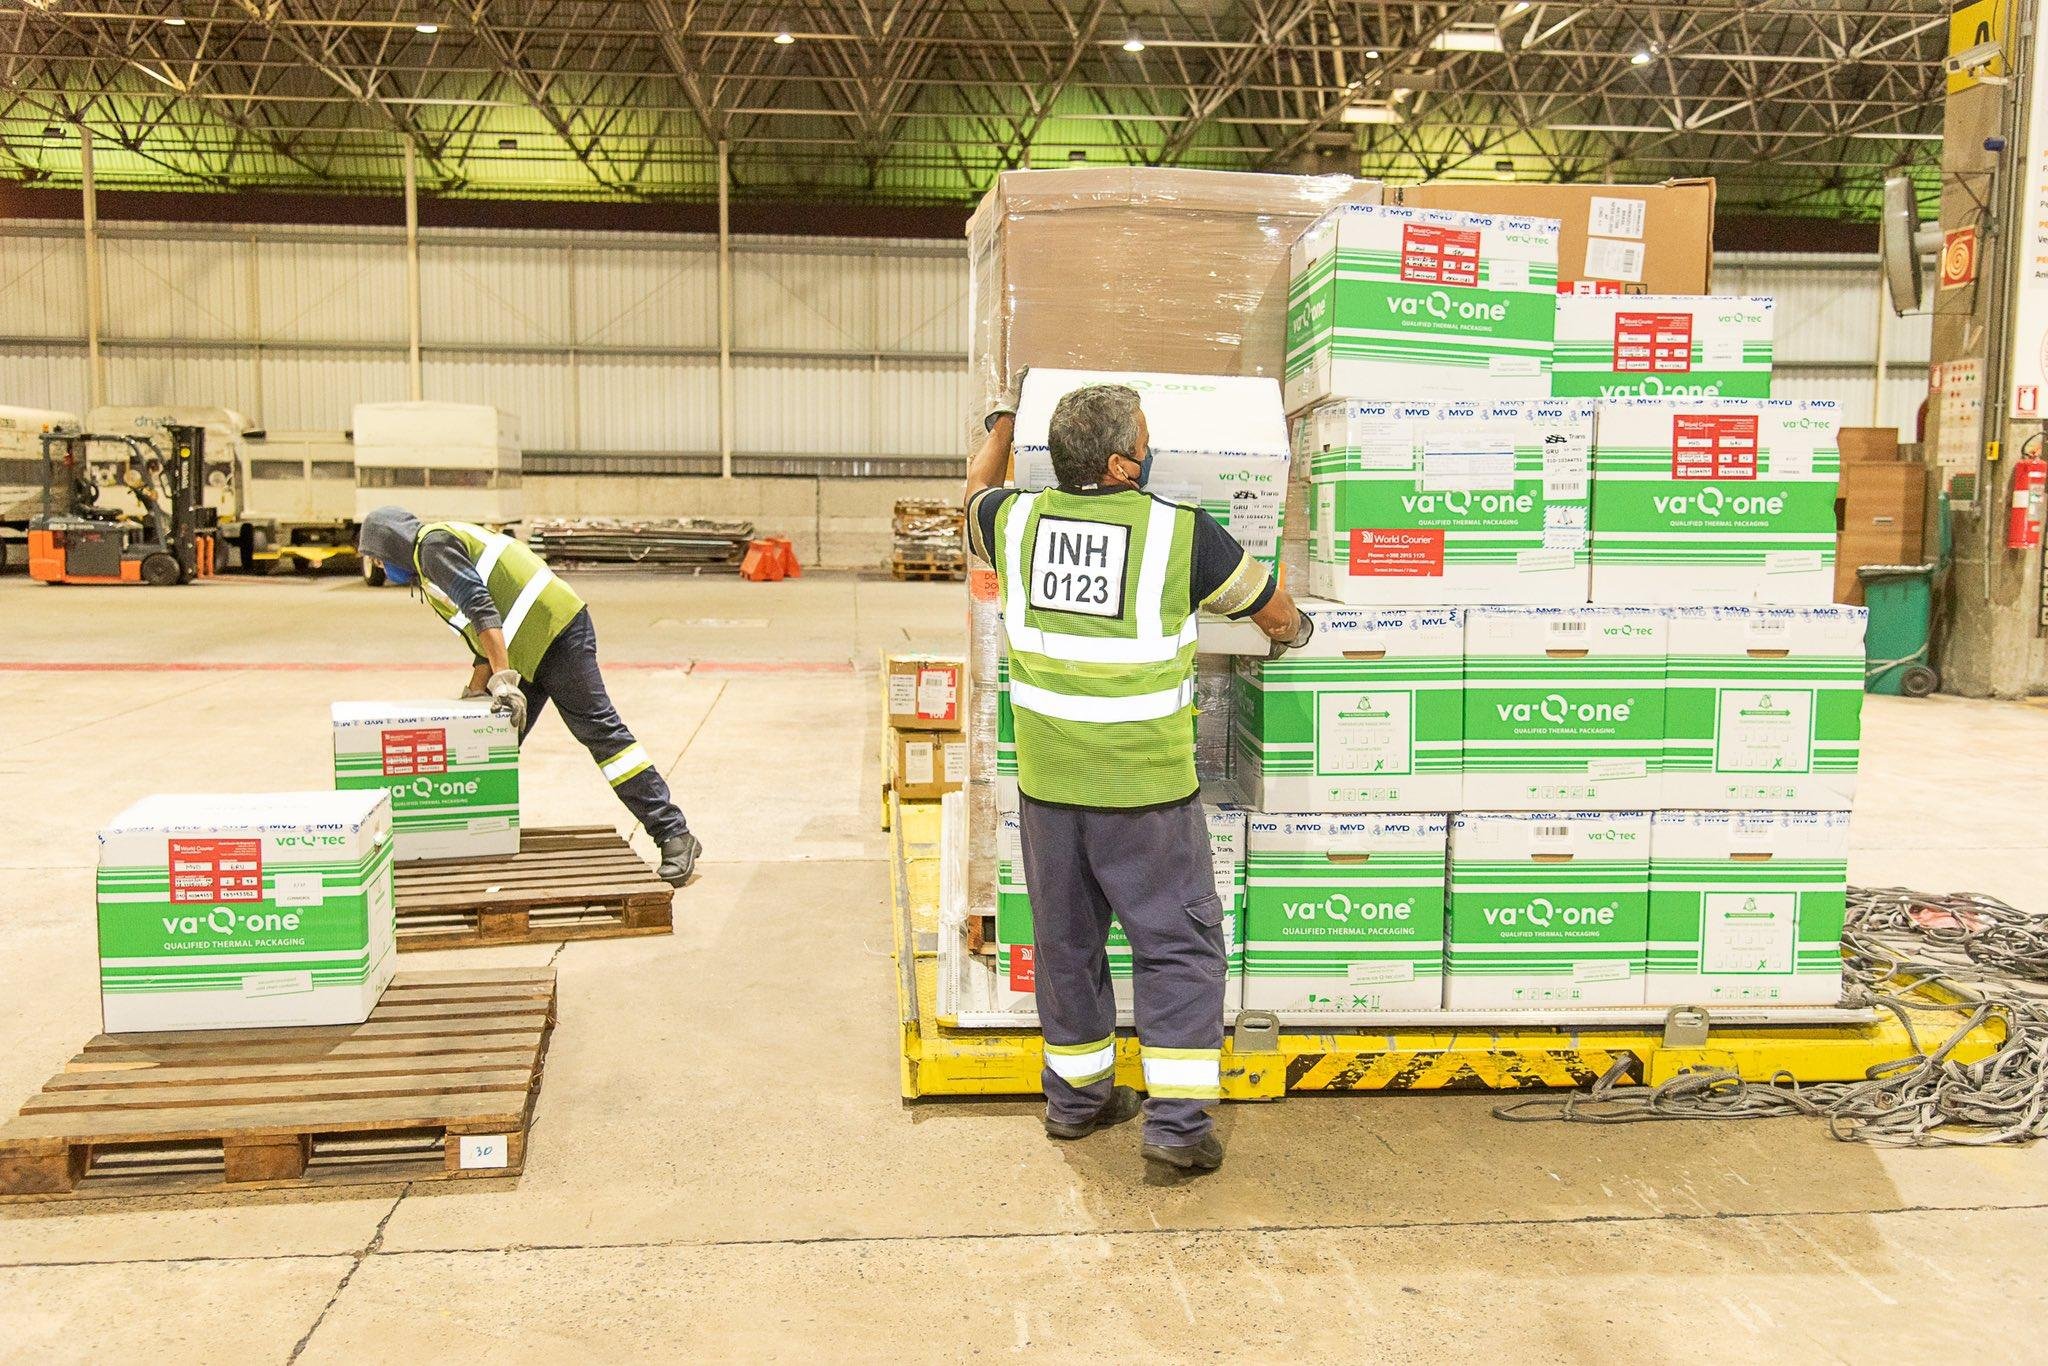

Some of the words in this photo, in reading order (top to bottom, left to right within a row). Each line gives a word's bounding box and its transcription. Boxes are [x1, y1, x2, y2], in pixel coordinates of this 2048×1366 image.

[1350, 205, 1373, 213] MVD
[1508, 222, 1531, 230] MVD
[1402, 320, 1432, 328] QUALIFIED
[1374, 535, 1400, 544] World
[1401, 535, 1431, 544] Courier
[1048, 532, 1108, 568] INH
[1042, 572, 1108, 604] 0123
[1282, 927, 1325, 935] QUALIFIED
[1327, 927, 1365, 935] THERMAL
[1368, 926, 1414, 935] PACKAGING
[164, 941, 210, 950] QUALIFIED
[212, 940, 252, 949] THERMAL
[255, 938, 305, 947] PACKAGING
[476, 1146, 492, 1157] 30
